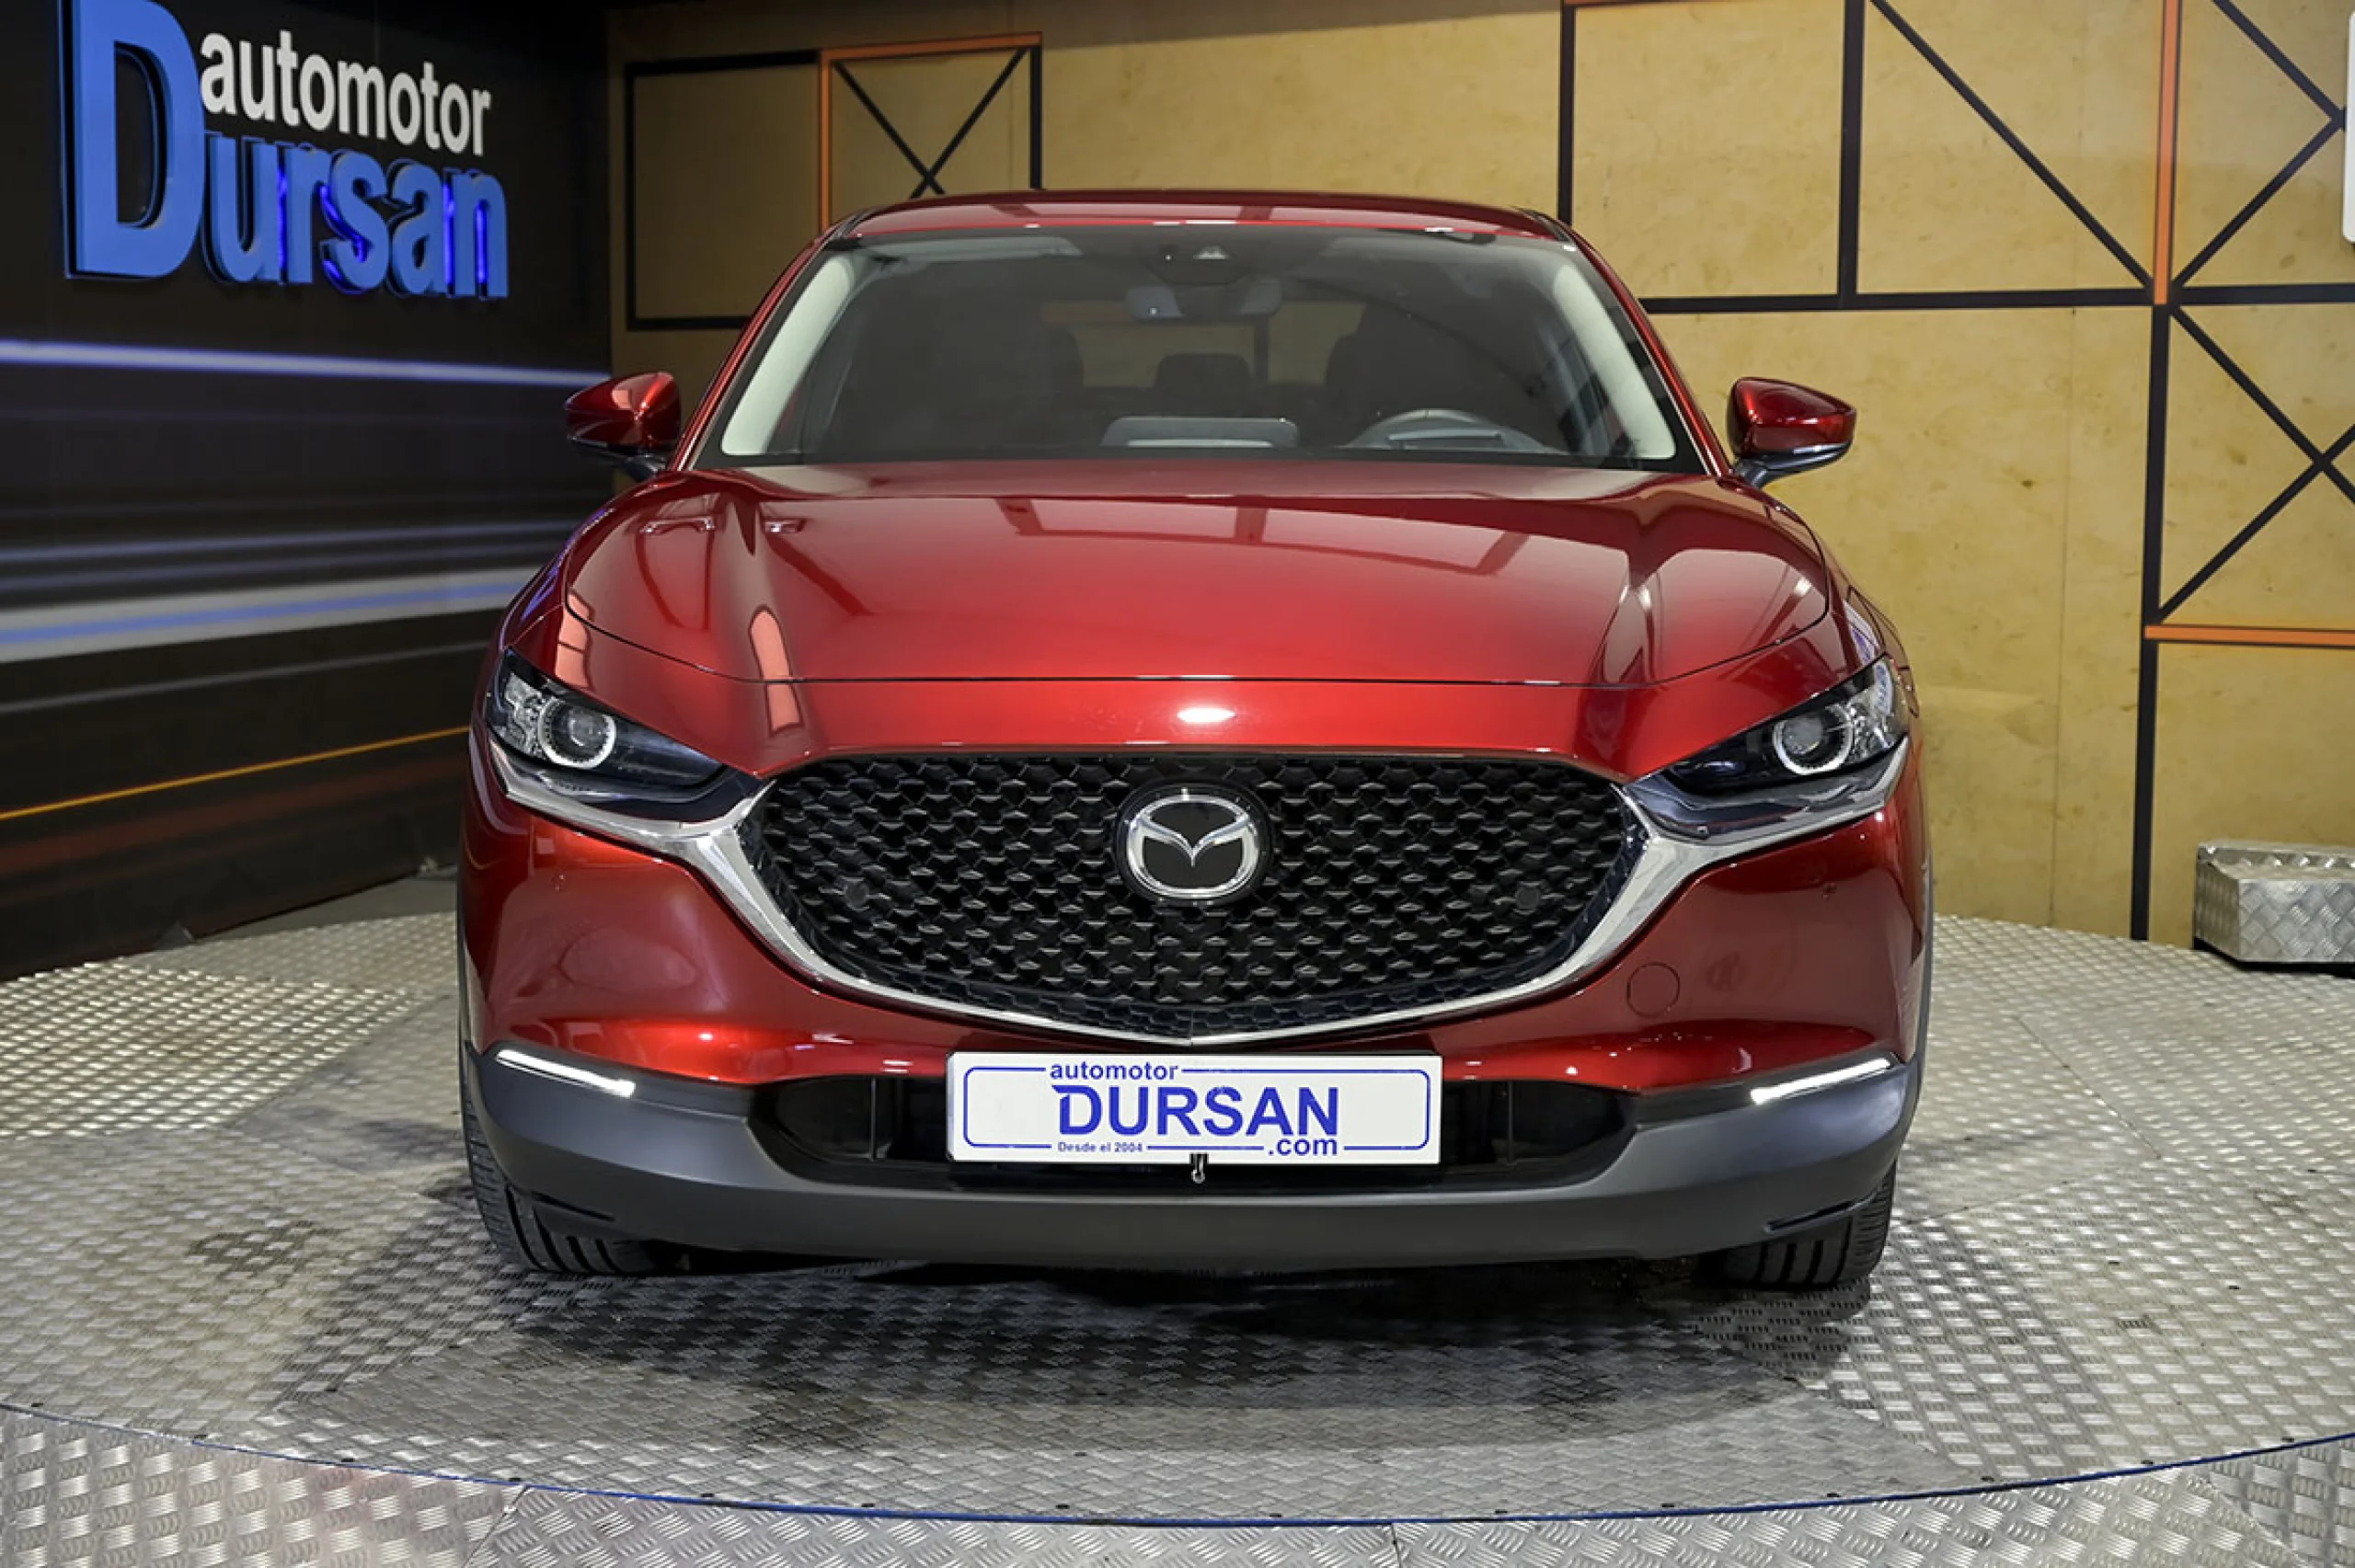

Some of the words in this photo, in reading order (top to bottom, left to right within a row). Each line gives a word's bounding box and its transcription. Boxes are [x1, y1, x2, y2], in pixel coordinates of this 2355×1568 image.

[200, 30, 491, 155] automotor
[62, 0, 509, 299] Dursan
[1049, 1060, 1178, 1081] automotor
[1051, 1084, 1339, 1137] DURSAN
[1057, 1141, 1097, 1153] Desde
[1099, 1141, 1111, 1153] el
[1114, 1141, 1143, 1153] 2004
[1268, 1138, 1338, 1157] .com
